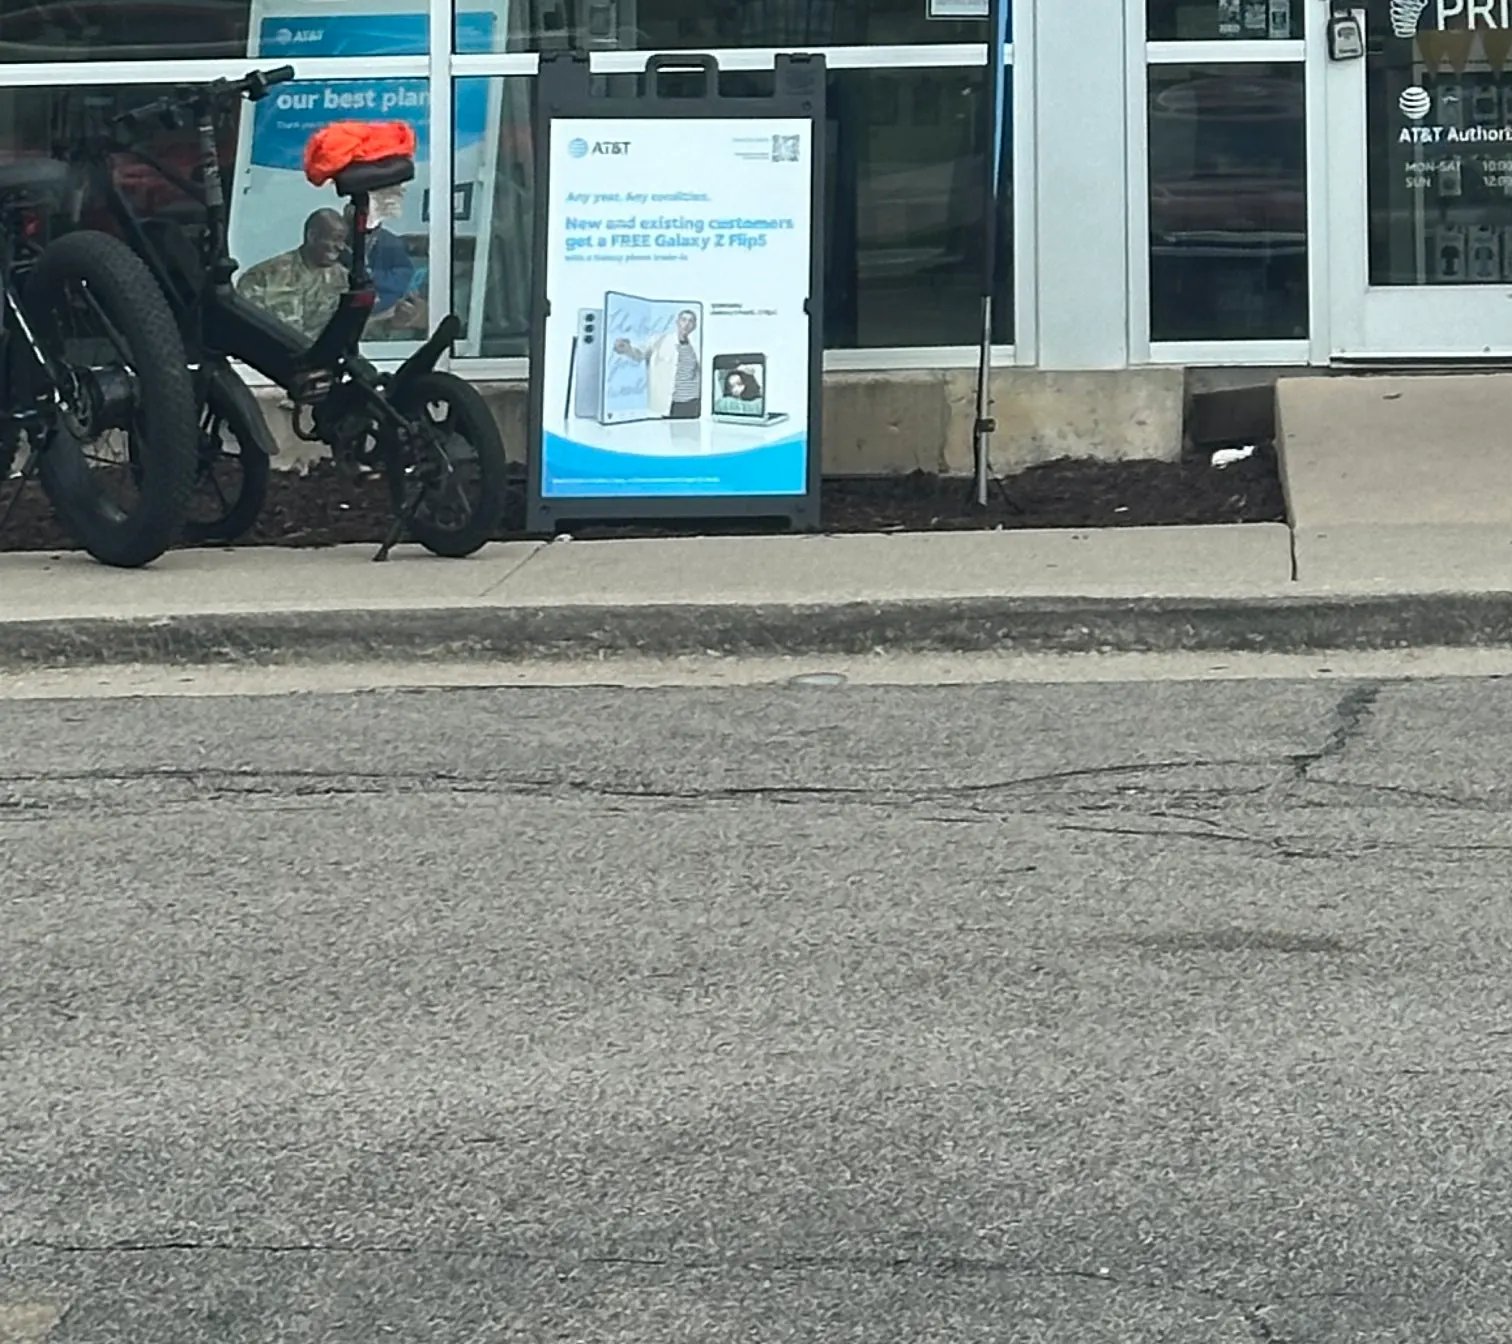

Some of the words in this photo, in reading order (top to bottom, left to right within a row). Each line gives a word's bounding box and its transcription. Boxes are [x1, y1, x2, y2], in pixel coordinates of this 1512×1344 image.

[293, 29, 325, 42] AT&T
[276, 94, 320, 110] our
[324, 88, 377, 109] best
[1399, 127, 1444, 143] AT&T
[591, 140, 632, 156] AT&T
[1405, 176, 1432, 188] SUN
[565, 216, 602, 230] New
[606, 216, 636, 230] and
[639, 215, 705, 234] existing
[708, 216, 794, 230] customers
[565, 235, 594, 251] get
[597, 237, 606, 248] a
[611, 234, 651, 248] FREE
[654, 233, 711, 251] Galaxy
[713, 234, 725, 248] Z
[728, 232, 768, 251] Flip5
